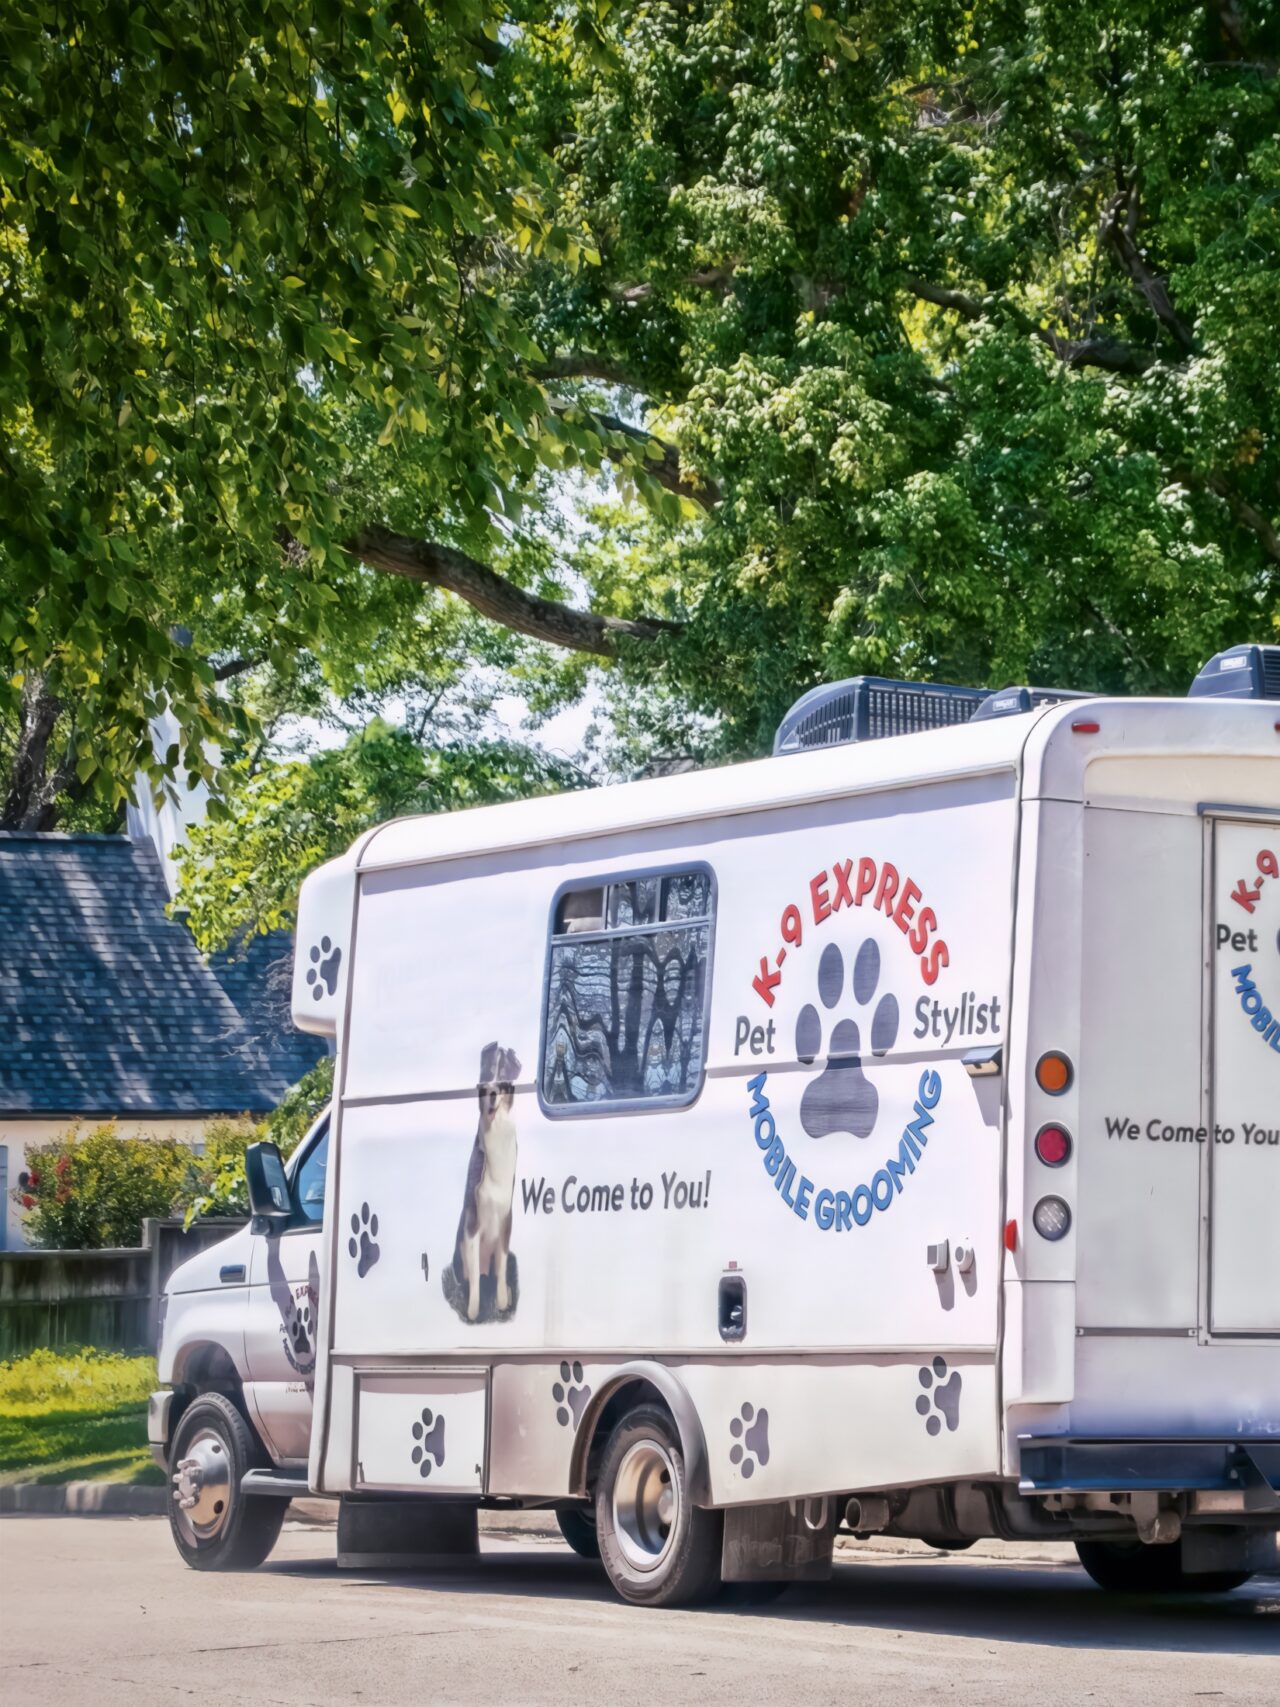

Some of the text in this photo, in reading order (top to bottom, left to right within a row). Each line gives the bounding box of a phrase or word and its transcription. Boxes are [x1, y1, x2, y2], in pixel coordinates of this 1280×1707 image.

[1231, 849, 1278, 914] K-9
[752, 857, 949, 1008] K-9 EXPRESS
[1216, 924, 1258, 953] Pet
[734, 992, 1001, 1056] Pet Stylist
[747, 1069, 942, 1232] MOBILE GROOMING
[1104, 1116, 1140, 1141] We
[1146, 1118, 1207, 1143] Come
[1213, 1124, 1235, 1144] to
[521, 1170, 711, 1215] We Come to You!
